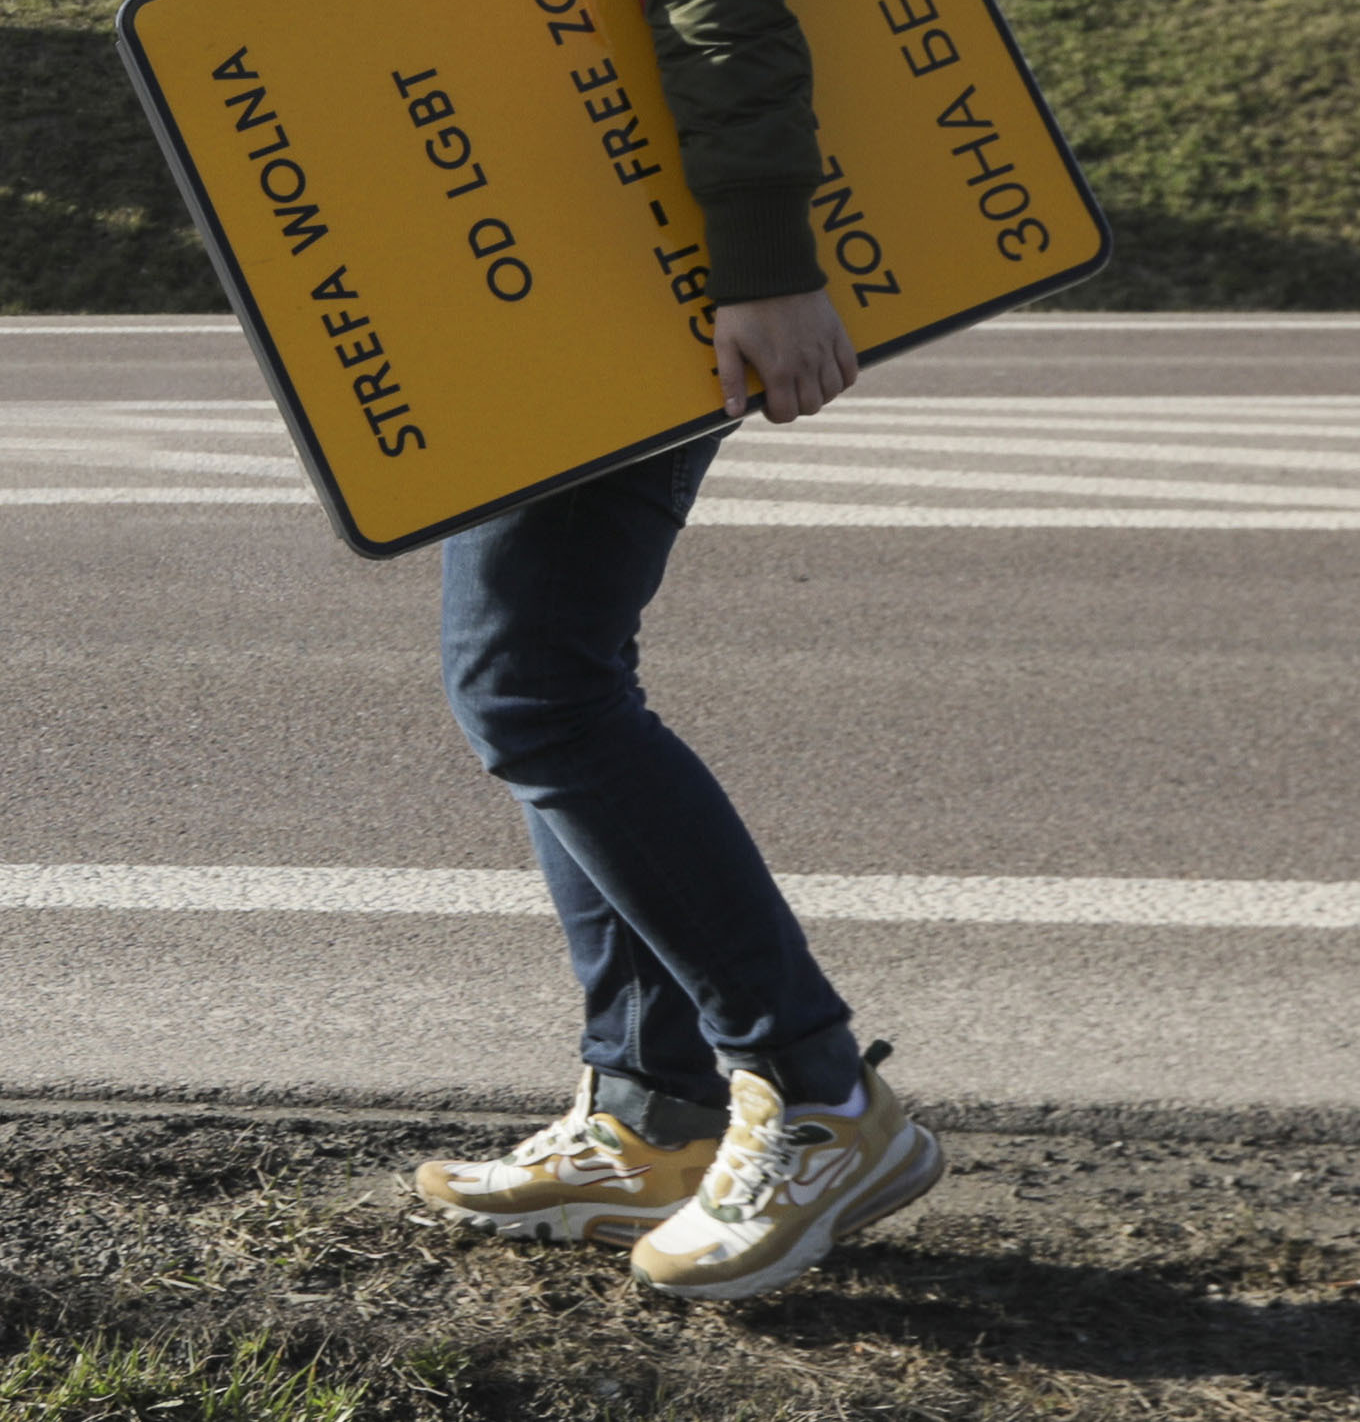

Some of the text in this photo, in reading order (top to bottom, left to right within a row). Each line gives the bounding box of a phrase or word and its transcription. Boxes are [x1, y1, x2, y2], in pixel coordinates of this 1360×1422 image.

[391, 68, 533, 303] OD LGBT
[569, 57, 663, 187] FREE
[935, 84, 1050, 262] ЗОНА
[211, 45, 427, 458] STREFA WOLNA
[653, 242, 720, 376] GBT
